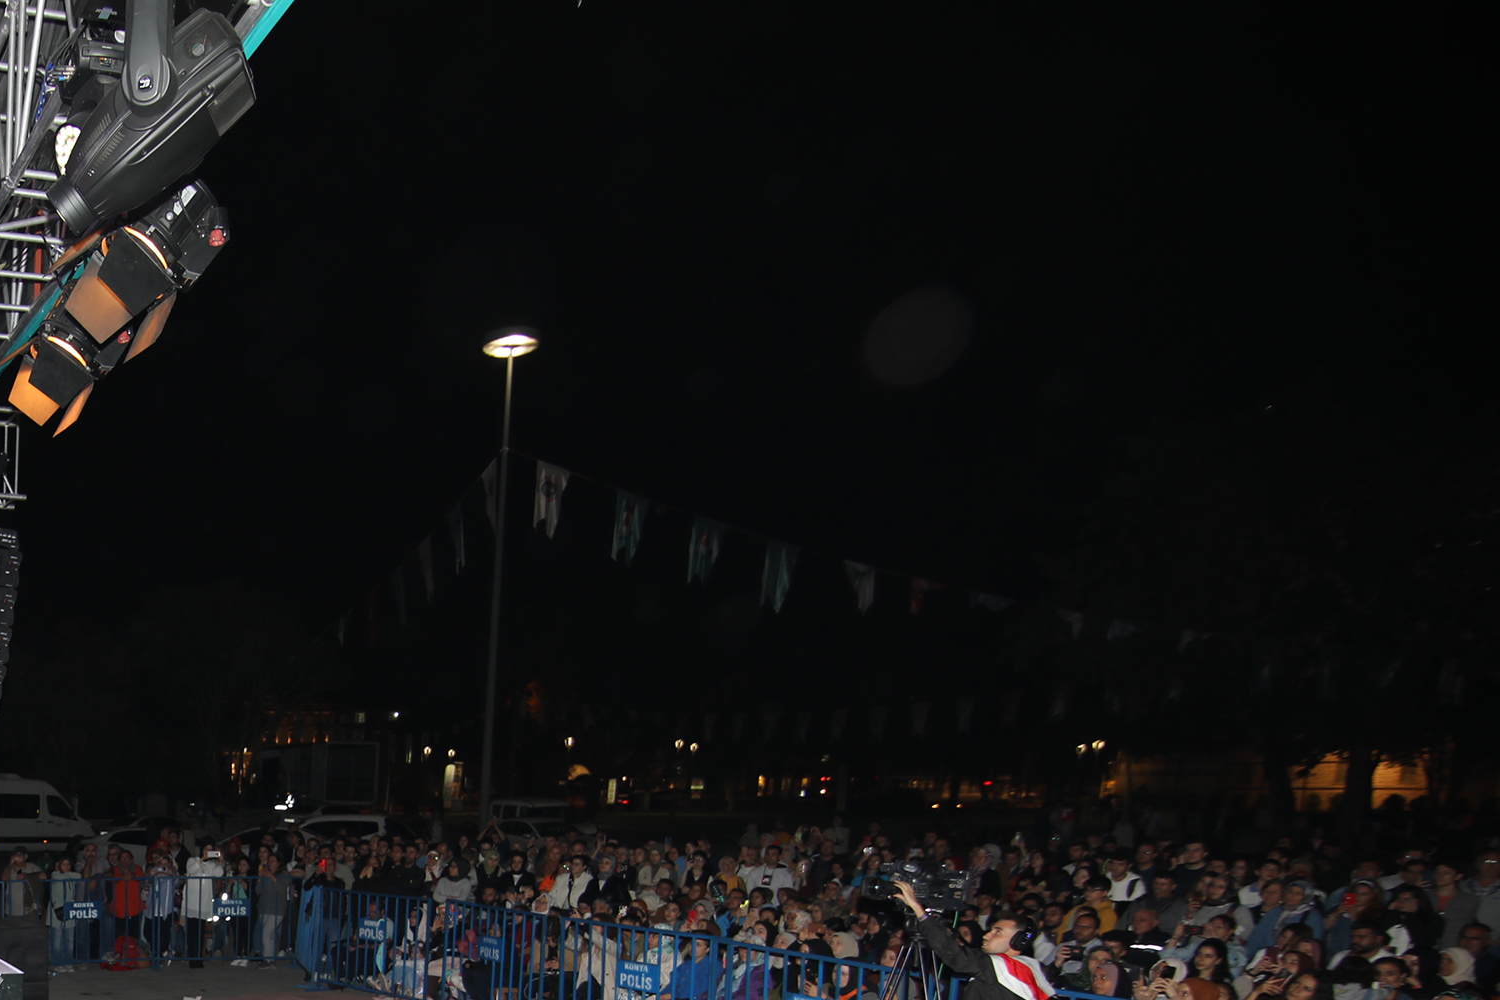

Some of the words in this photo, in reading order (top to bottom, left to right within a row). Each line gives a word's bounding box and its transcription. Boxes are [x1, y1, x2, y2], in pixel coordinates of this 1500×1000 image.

[69, 908, 98, 919] POLİS
[217, 905, 247, 916] POLİS
[359, 928, 384, 940] POLİS
[480, 946, 500, 960] POLİS
[624, 962, 649, 973] KONYA
[620, 973, 653, 991] POLİS
